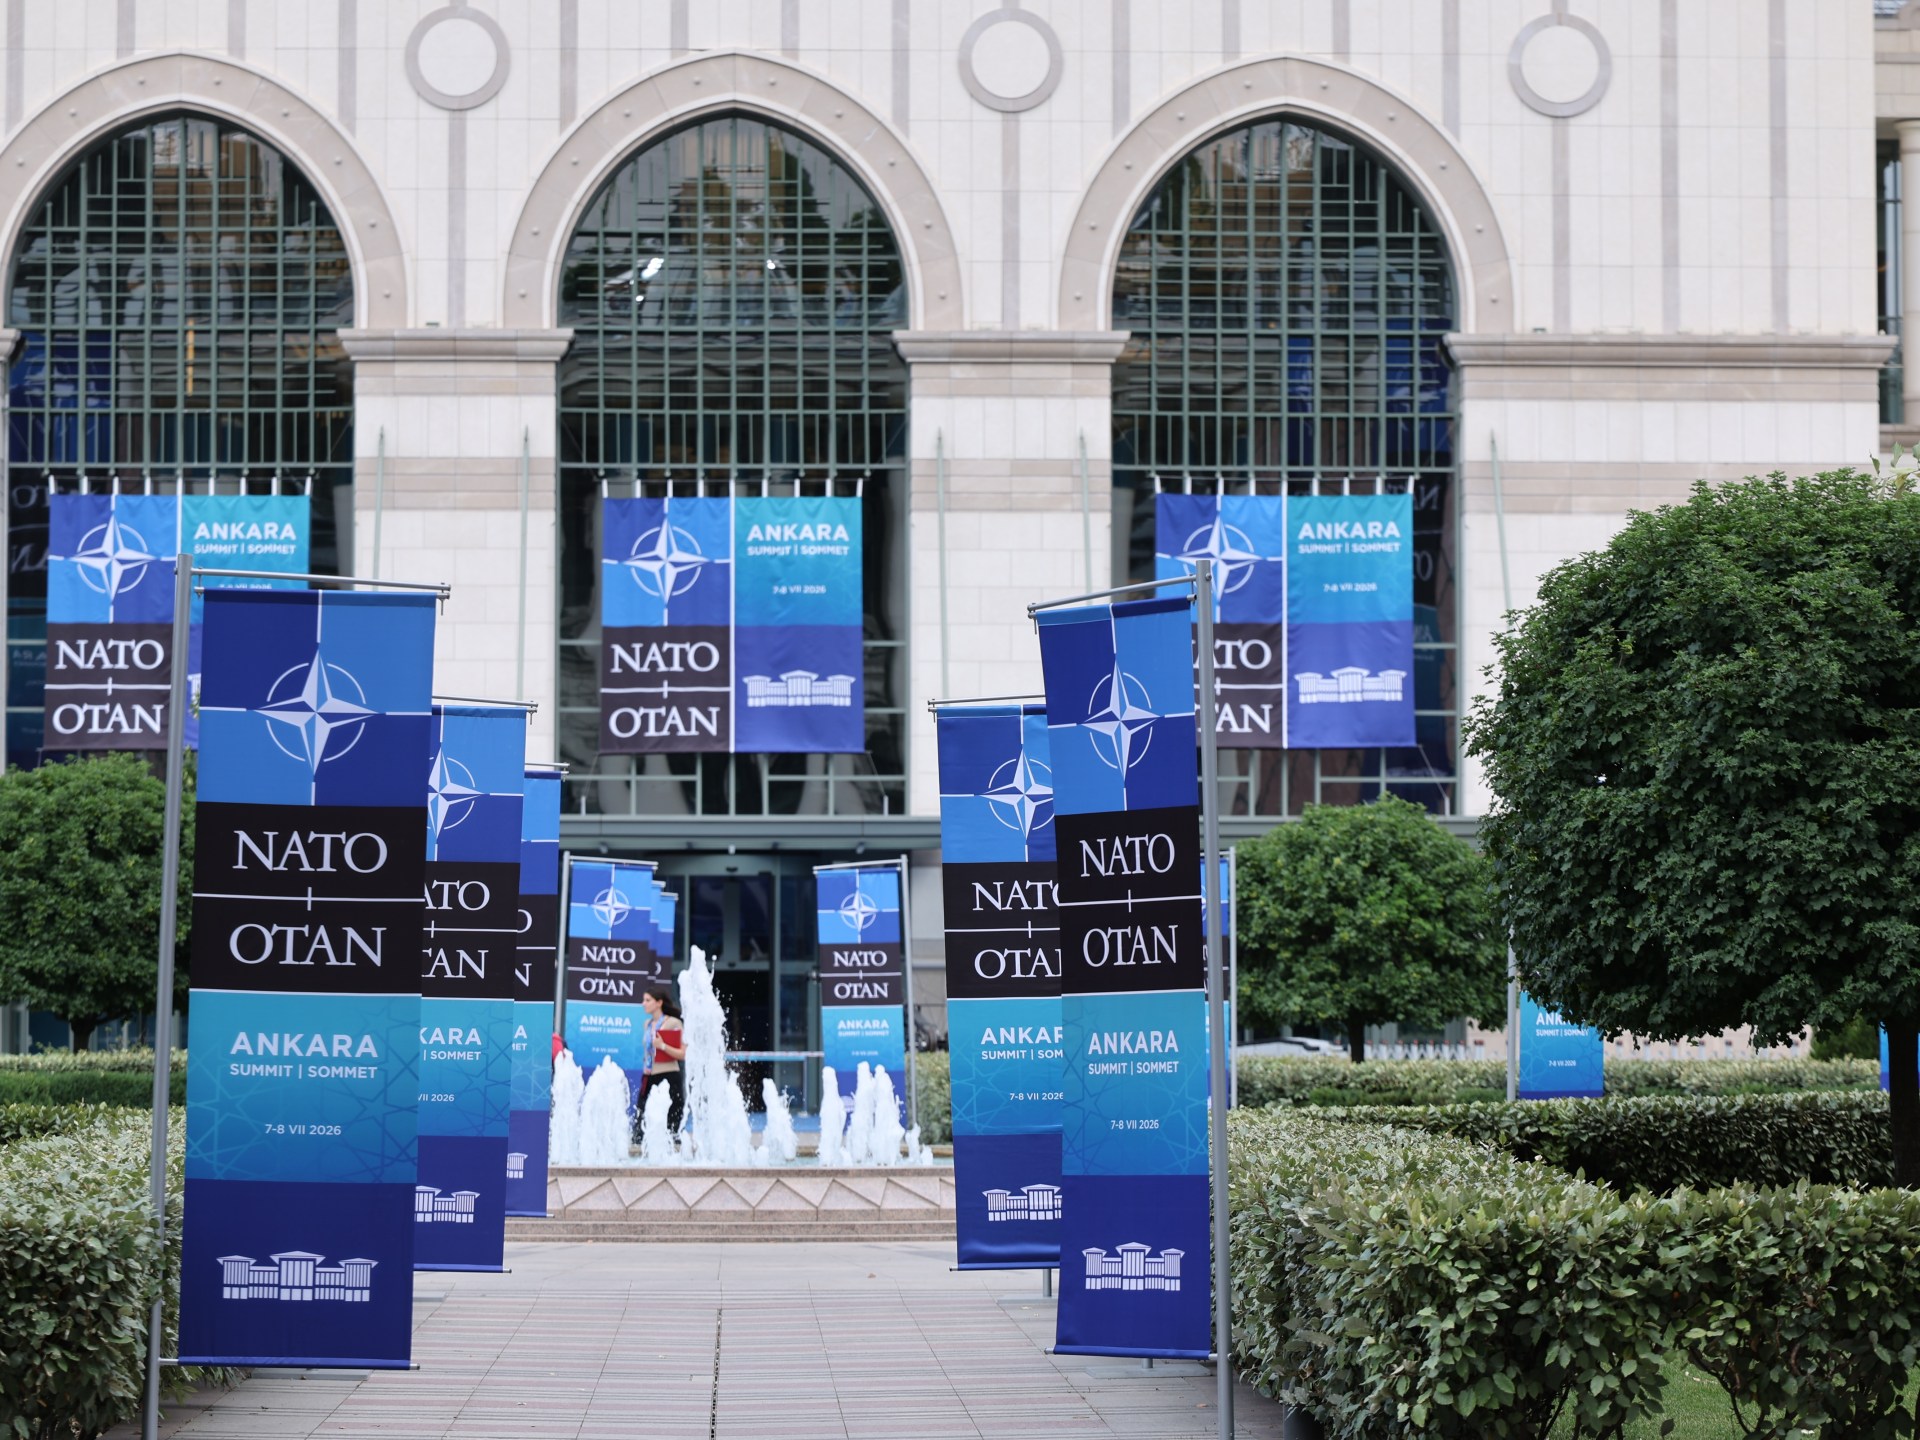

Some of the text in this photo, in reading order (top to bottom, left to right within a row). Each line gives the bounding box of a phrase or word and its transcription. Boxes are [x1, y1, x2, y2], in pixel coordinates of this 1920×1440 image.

[194, 522, 297, 540] ANKARA
[747, 524, 850, 542] ANKARA
[1298, 521, 1401, 540] ANKARA
[194, 543, 297, 555] SUMMIT SOMMET
[747, 545, 850, 556] SUMMIT SOMMET
[1298, 542, 1401, 554] SUMMIT SOMMET
[54, 638, 165, 670] NATO
[609, 641, 720, 673] NATO
[52, 702, 164, 734] OTAN
[608, 705, 720, 738] OTAN
[232, 830, 388, 873] NATO
[1079, 833, 1175, 877] NATO
[229, 923, 387, 967] OTAN
[1082, 924, 1178, 967] OTAN
[581, 945, 636, 964] NATO
[832, 950, 888, 967] NATO
[974, 947, 1062, 980] OTA
[579, 977, 635, 996] OTAN
[833, 982, 889, 999] OTAN
[580, 1014, 632, 1027] ANKARA
[837, 1019, 890, 1030] ANKARA
[230, 1031, 379, 1058] ANKARA
[980, 1026, 1063, 1045] ANKAR
[1088, 1030, 1179, 1055] ANKARA
[430, 1050, 481, 1061] SOMMET
[981, 1049, 1063, 1060] SUMMIT SOM
[230, 1063, 378, 1079] SUMMIT SOMMET
[1088, 1061, 1179, 1075] SUMMIT SOMMET
[431, 1094, 455, 1102] 2026
[1010, 1092, 1024, 1101] 7-8
[1027, 1092, 1039, 1101] VII
[265, 1124, 342, 1135] 7-8 VII 2026
[1110, 1119, 1159, 1130] 7-8 VII 2026
